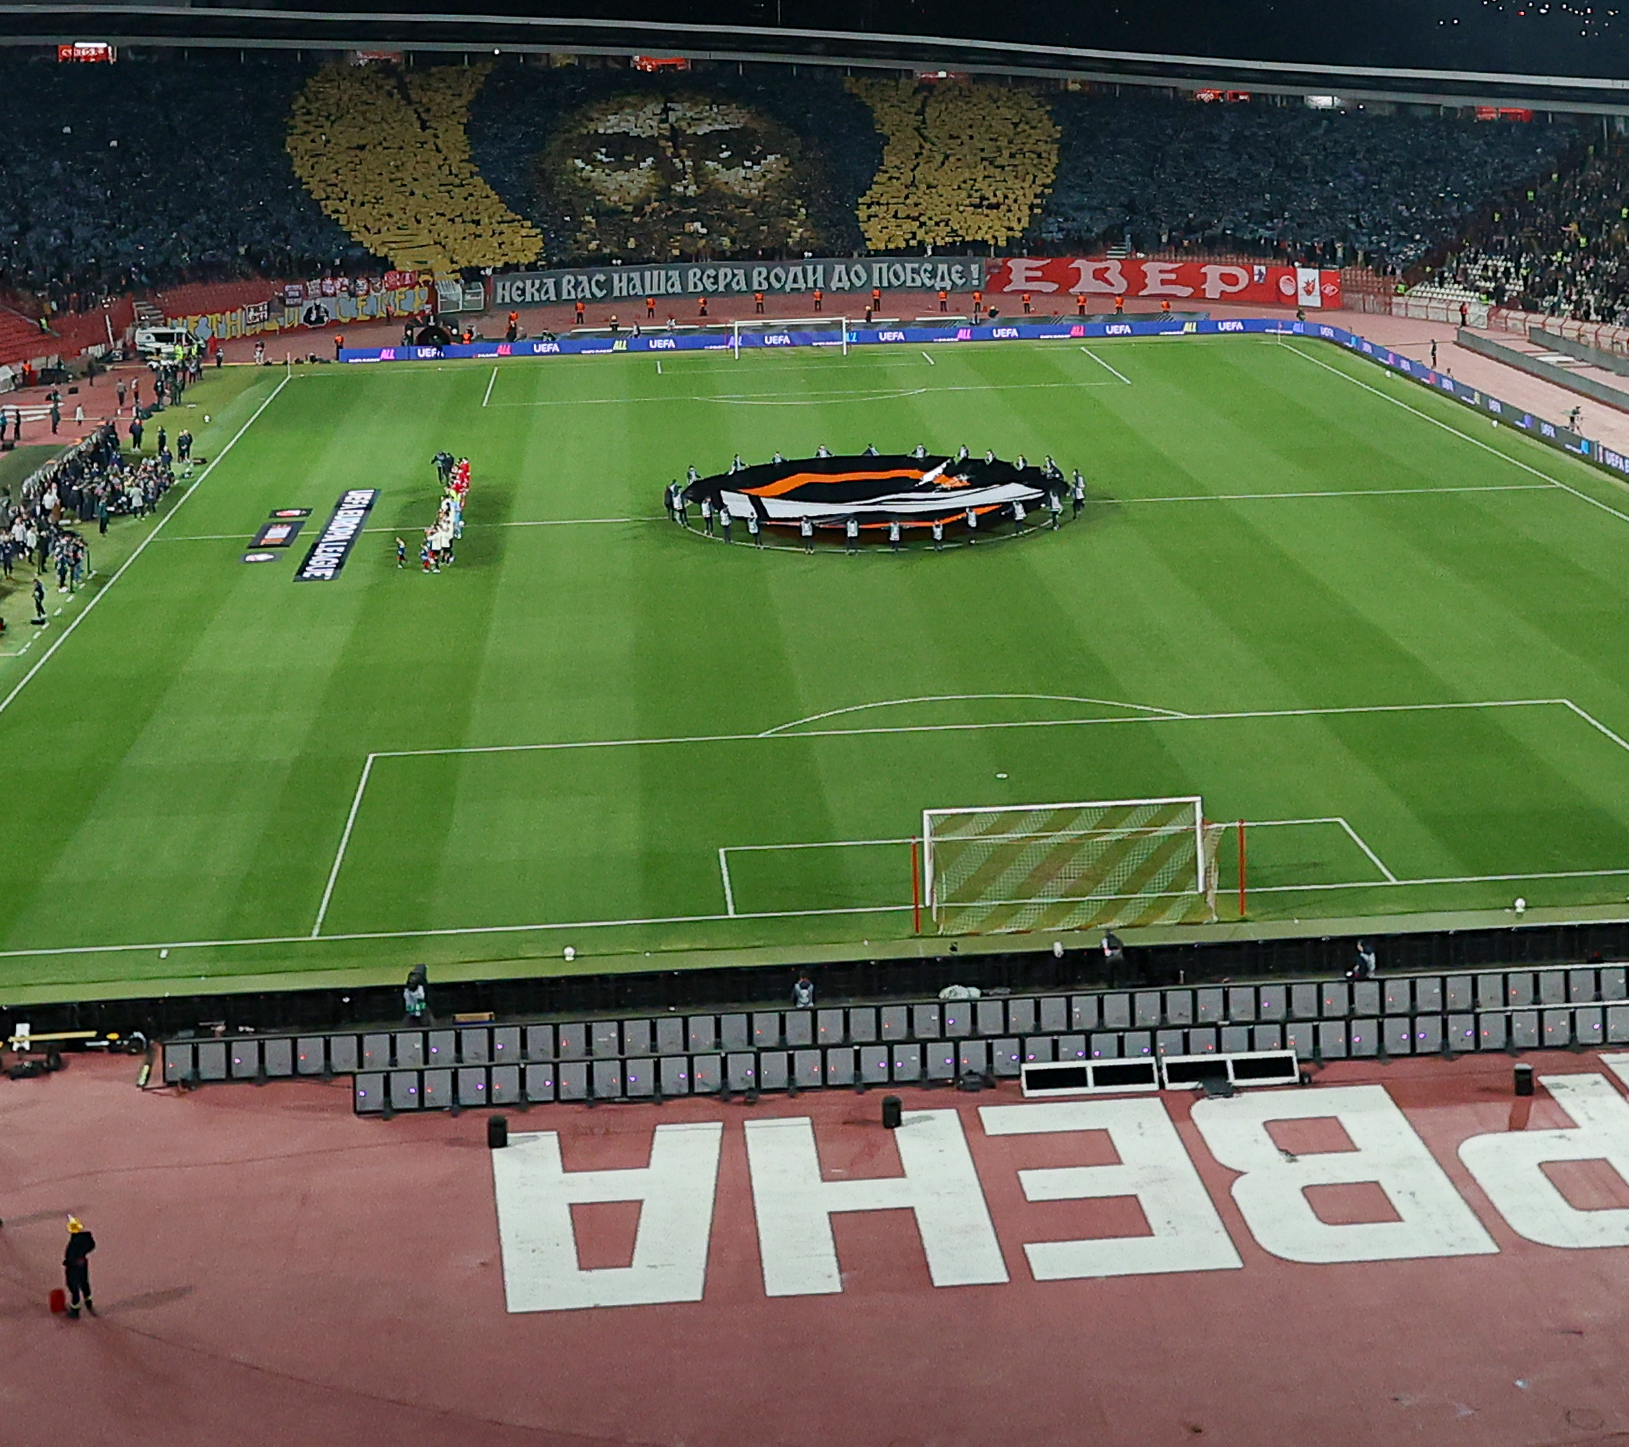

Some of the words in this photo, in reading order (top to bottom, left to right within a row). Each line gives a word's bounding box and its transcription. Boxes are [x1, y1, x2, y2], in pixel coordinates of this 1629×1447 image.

[496, 277, 557, 304] НЕКА
[562, 272, 608, 300] ВАС
[613, 269, 683, 297] НАША
[687, 265, 748, 294] ВЕРА
[753, 263, 824, 292] ВОДИ
[830, 263, 868, 291] ДО
[986, 258, 1250, 299] ЕВЕР
[1105, 324, 1132, 335] UEFA
[1217, 320, 1244, 331] UEFA
[879, 331, 905, 342] UEFA
[992, 327, 1019, 338] UEFA
[649, 338, 675, 349] UEFA
[764, 334, 790, 345] UEFA
[533, 342, 560, 353] UEFA
[1605, 450, 1624, 471] UEFA
[339, 489, 375, 510] UEFA
[320, 509, 366, 543] EUROPA
[302, 541, 349, 580] LEAGUE
